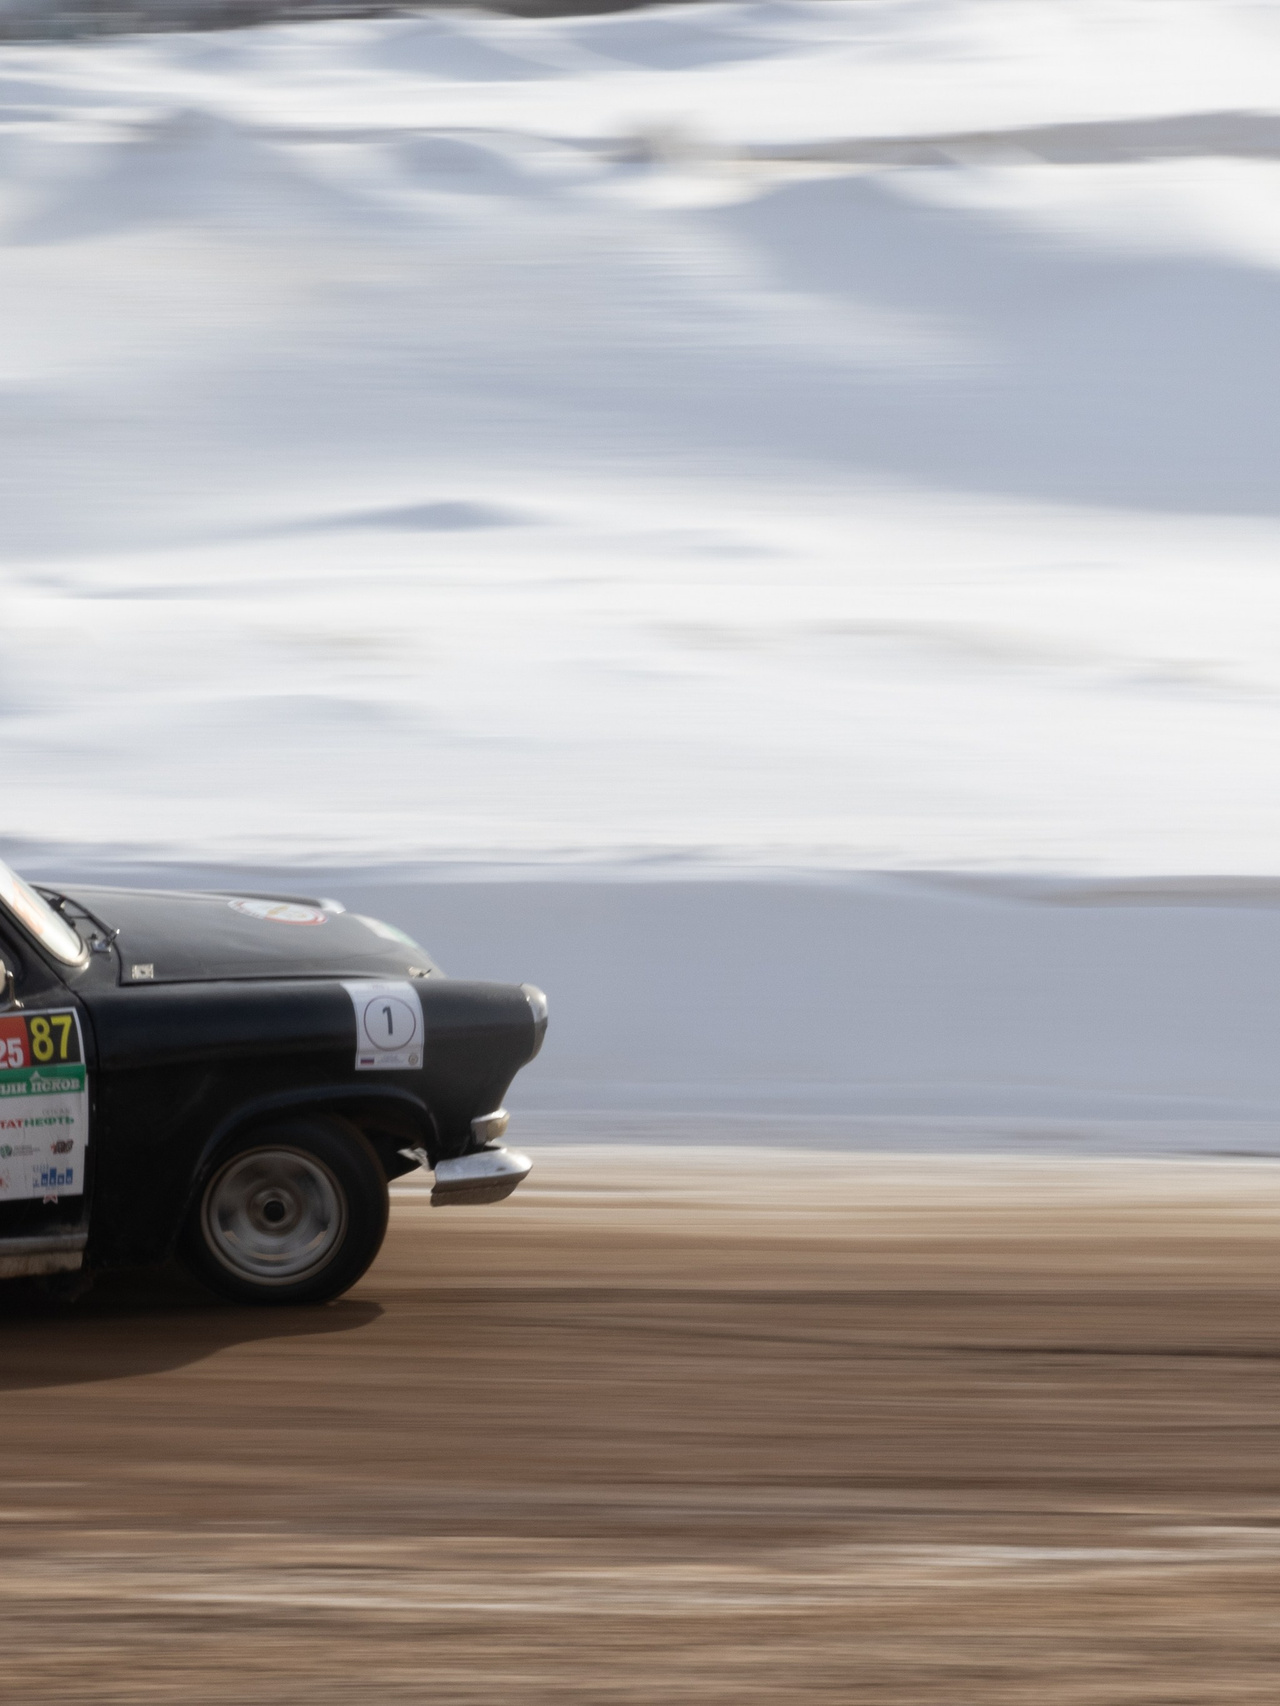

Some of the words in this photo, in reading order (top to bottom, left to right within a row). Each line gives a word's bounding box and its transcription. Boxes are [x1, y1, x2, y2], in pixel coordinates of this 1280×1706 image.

[382, 1005, 394, 1036] 1
[30, 1015, 72, 1062] 87
[31, 1076, 81, 1093] ПСКОВ
